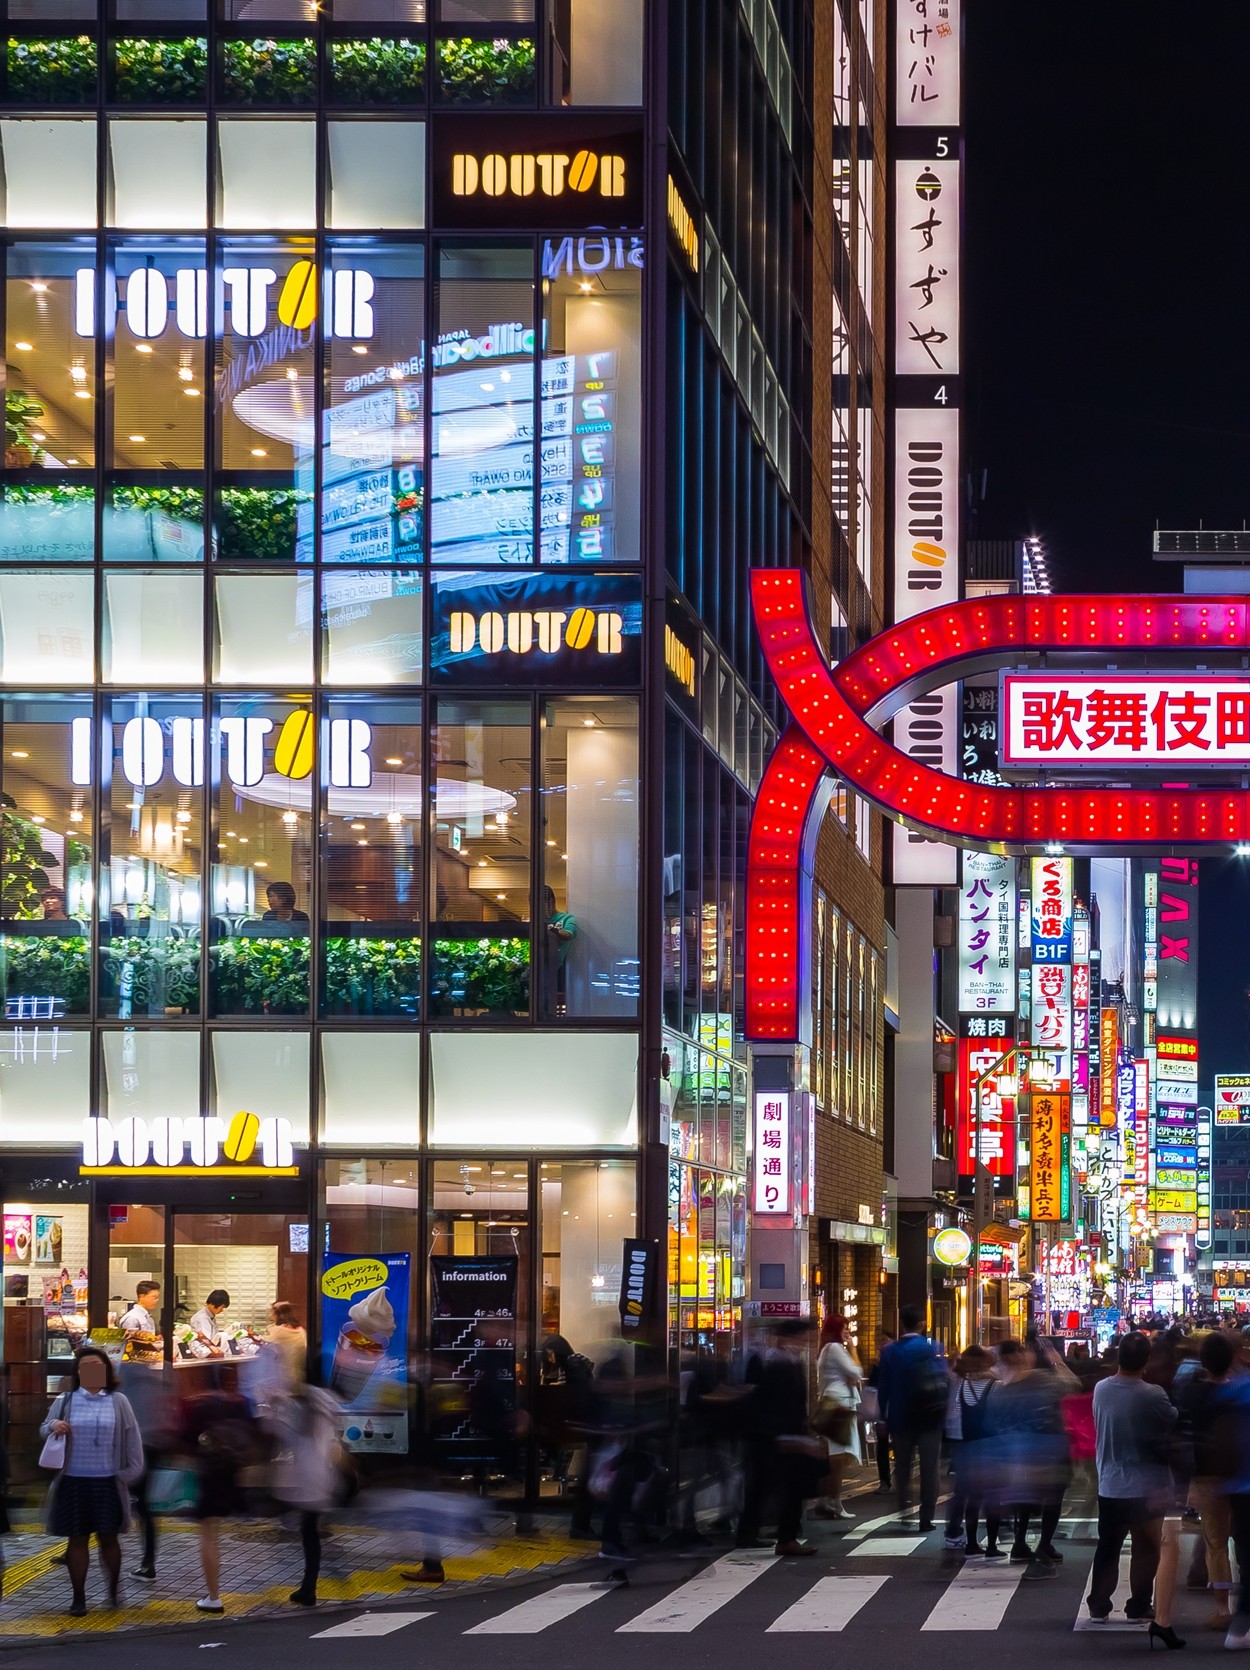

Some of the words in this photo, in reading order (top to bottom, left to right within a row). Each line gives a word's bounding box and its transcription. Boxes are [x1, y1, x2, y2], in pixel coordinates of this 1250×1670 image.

[936, 137, 948, 157] 5
[453, 150, 625, 197] DOUTOR
[908, 207, 948, 369] すずや
[934, 386, 948, 404] 4
[907, 441, 947, 591] DOUTOR
[449, 607, 622, 654] DOUTOR
[966, 878, 994, 975] バンタイ
[998, 879, 1009, 969] タイ国料理専門店
[1036, 945, 1067, 958] B1F
[976, 997, 997, 1008] 3F
[968, 1018, 1005, 1037] 焼肉
[1158, 1042, 1196, 1055] 全店営業中
[763, 1101, 782, 1202] 劇場通り
[324, 1263, 380, 1287] ドトールオリジナル
[331, 1274, 385, 1296] ソフトクリーム
[442, 1270, 507, 1281] information
[624, 1250, 646, 1327] DOUTOR
[474, 1309, 485, 1317] 4F
[474, 1339, 486, 1347] 3F
